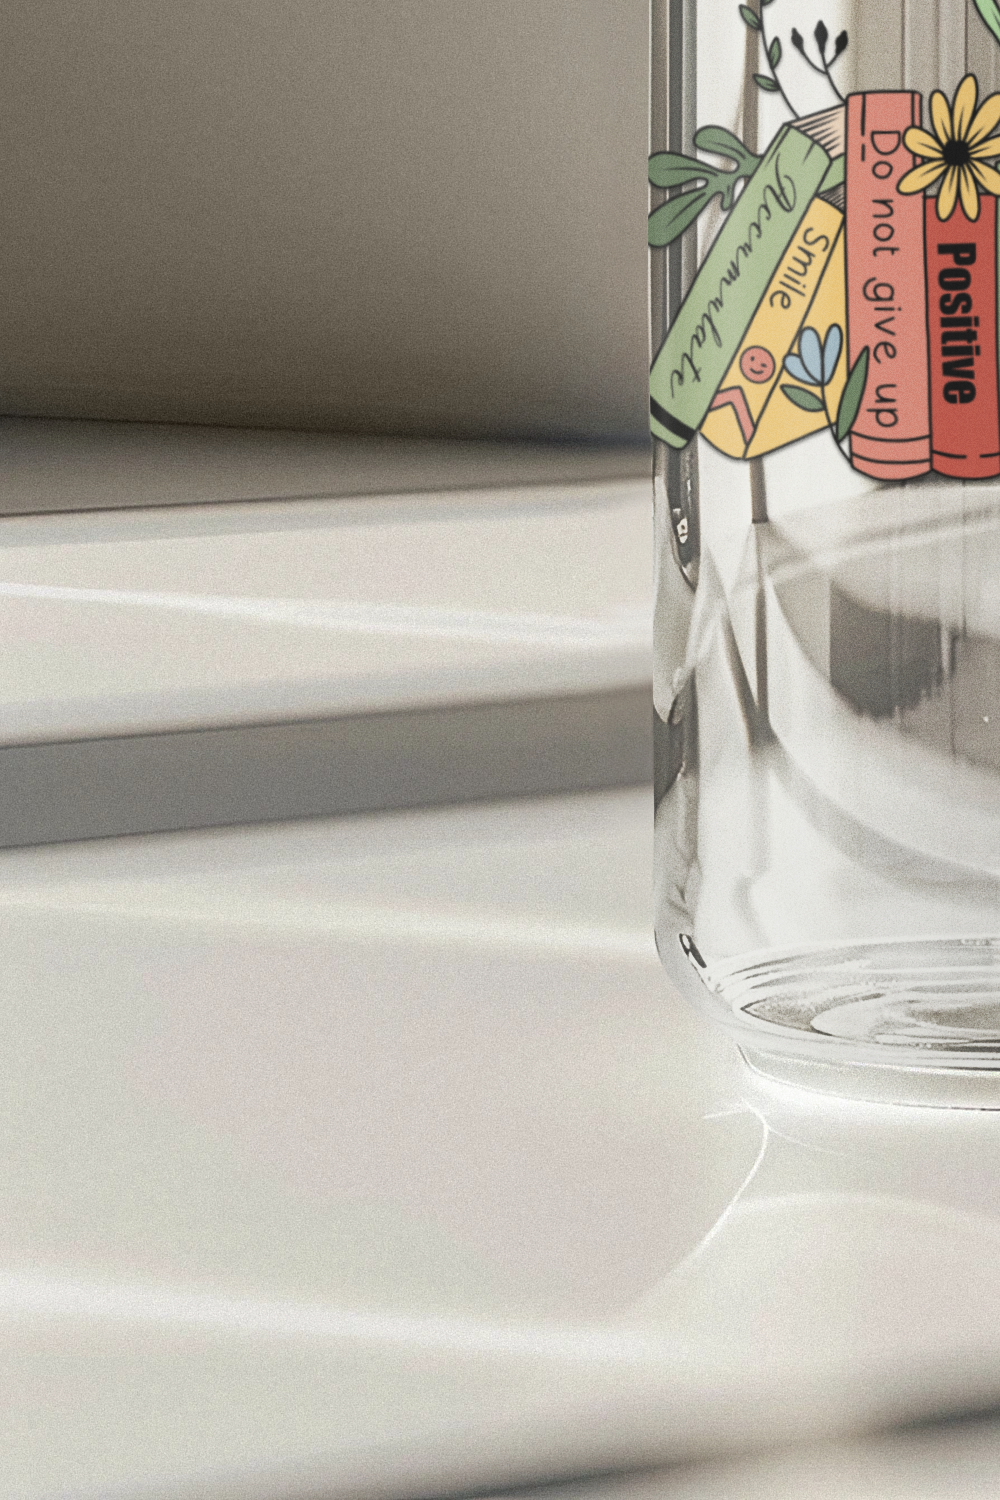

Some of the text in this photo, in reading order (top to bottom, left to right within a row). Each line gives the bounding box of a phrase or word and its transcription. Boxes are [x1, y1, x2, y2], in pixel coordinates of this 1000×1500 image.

[670, 152, 797, 400] Accumulate
[769, 226, 830, 311] Smile
[862, 129, 903, 428] Do not give up
[936, 241, 981, 405] Positive
